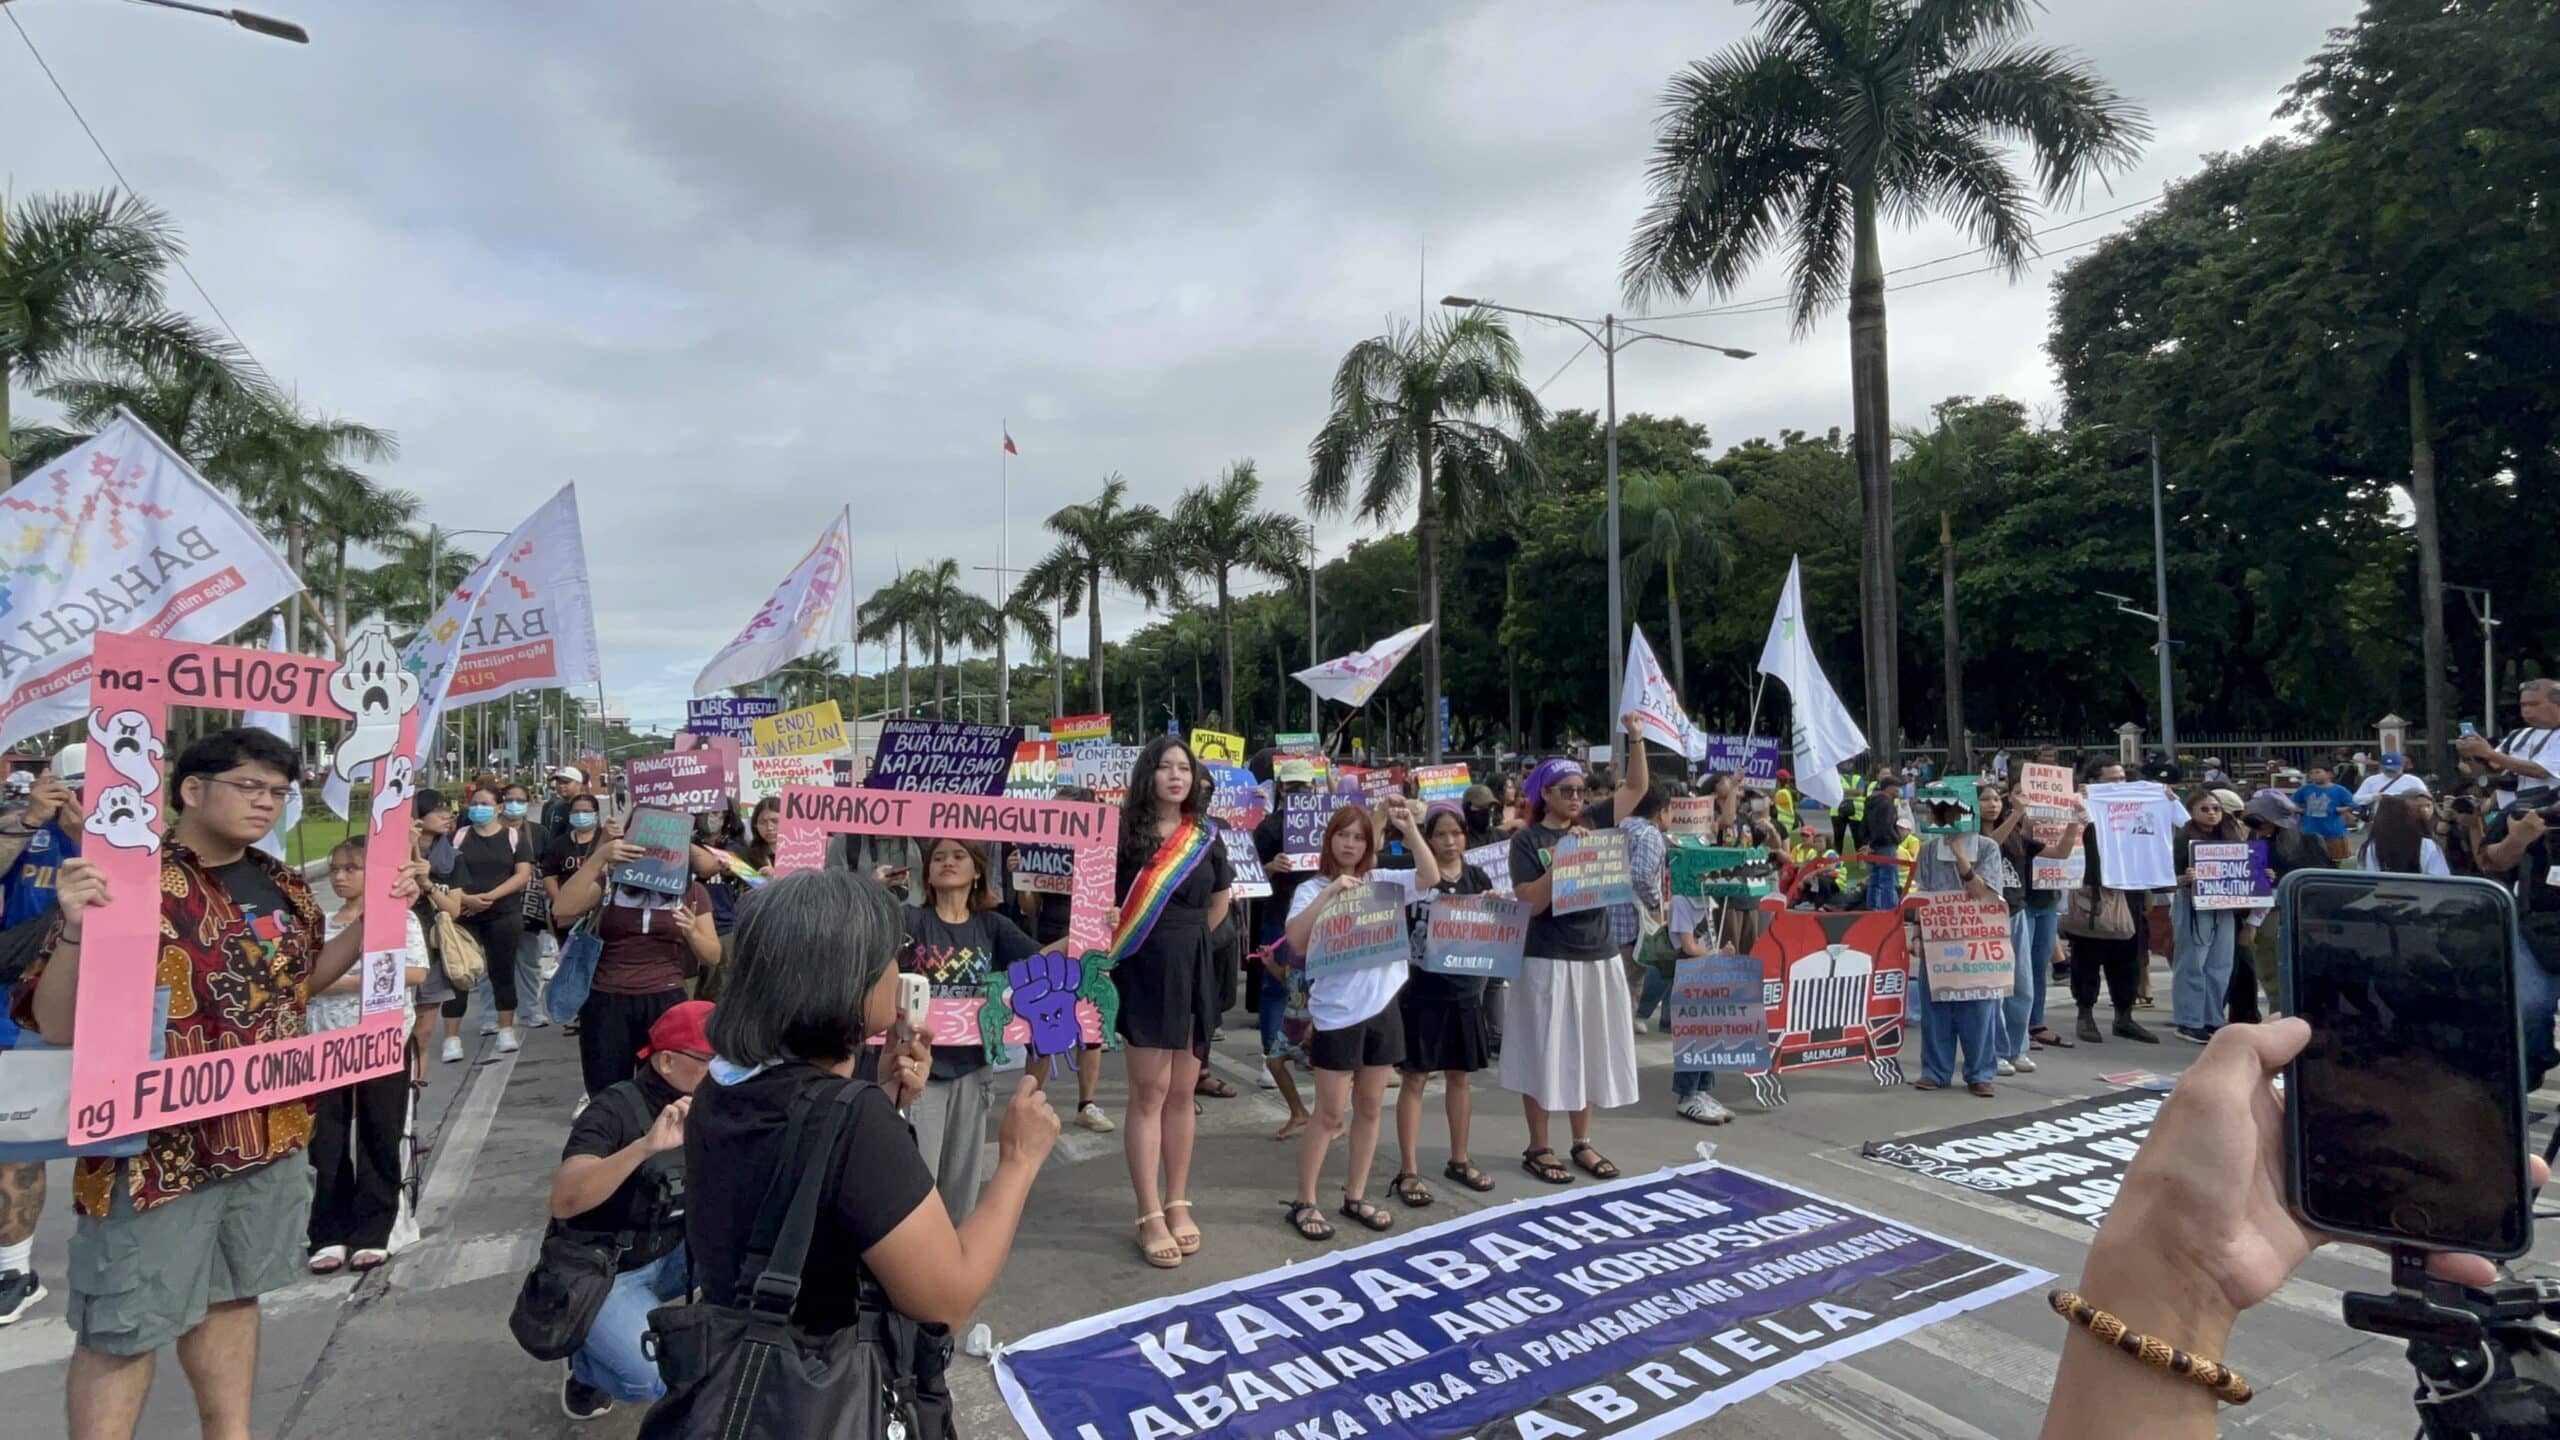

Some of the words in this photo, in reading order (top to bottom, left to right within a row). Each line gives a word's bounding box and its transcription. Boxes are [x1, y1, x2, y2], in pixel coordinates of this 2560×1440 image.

[690, 699, 732, 717] LABIS
[774, 711, 815, 735] ENDO
[936, 723, 958, 734] ANG
[894, 734, 1001, 755] BURUKRATA
[633, 756, 697, 775] PANAGUTIN
[753, 758, 803, 771] MARCOS
[880, 754, 1006, 775] KAPITALISMO
[893, 775, 994, 796] IBAGSAK!
[2029, 780, 2049, 791] THE
[1287, 795, 1324, 811] LAGOT
[786, 792, 912, 828] KURAKOT
[930, 801, 1107, 842] PANAGUTIN!
[2197, 880, 2256, 896] PANAGUTIN!
[1931, 926, 2006, 939] KATUMBAS
[1967, 940, 2005, 961] 715
[1679, 1005, 1748, 1017] AGAINST
[1672, 1020, 1761, 1038] CORRUPTION!
[1802, 1047, 1848, 1062] SALINLAHI
[77, 1099, 115, 1138] ng
[133, 1058, 235, 1119] FLOOD
[245, 1046, 318, 1095] CONTROL
[319, 1027, 403, 1082] PROJECTS
[1131, 1187, 1733, 1379] KABABAIHAN
[1430, 1286, 1565, 1344] ANG
[1554, 1204, 1851, 1296] KORUPSYON!
[1364, 1372, 1478, 1426] PARA
[1469, 1351, 1532, 1385] SA
[1522, 1275, 1747, 1367] PAMBANSANG
[1731, 1225, 1919, 1293] DEMOKRASYA!
[1466, 1299, 1875, 1440] ABRIELA
